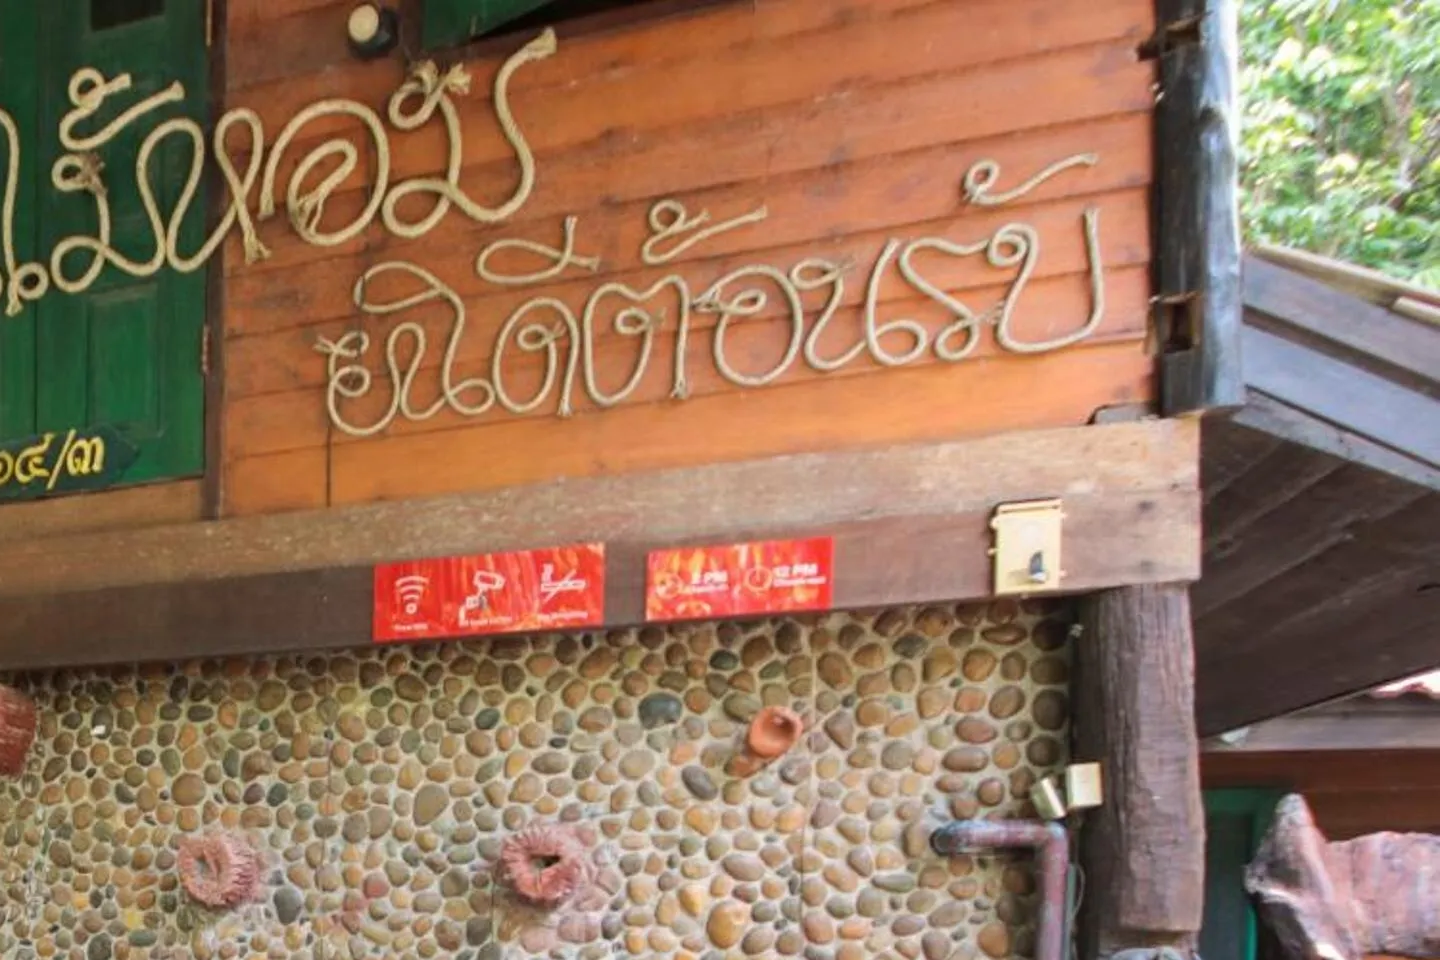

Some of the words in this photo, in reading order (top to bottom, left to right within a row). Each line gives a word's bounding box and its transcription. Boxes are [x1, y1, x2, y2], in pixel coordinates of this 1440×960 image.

[314, 151, 1101, 435] ยินดีต้อนรับ
